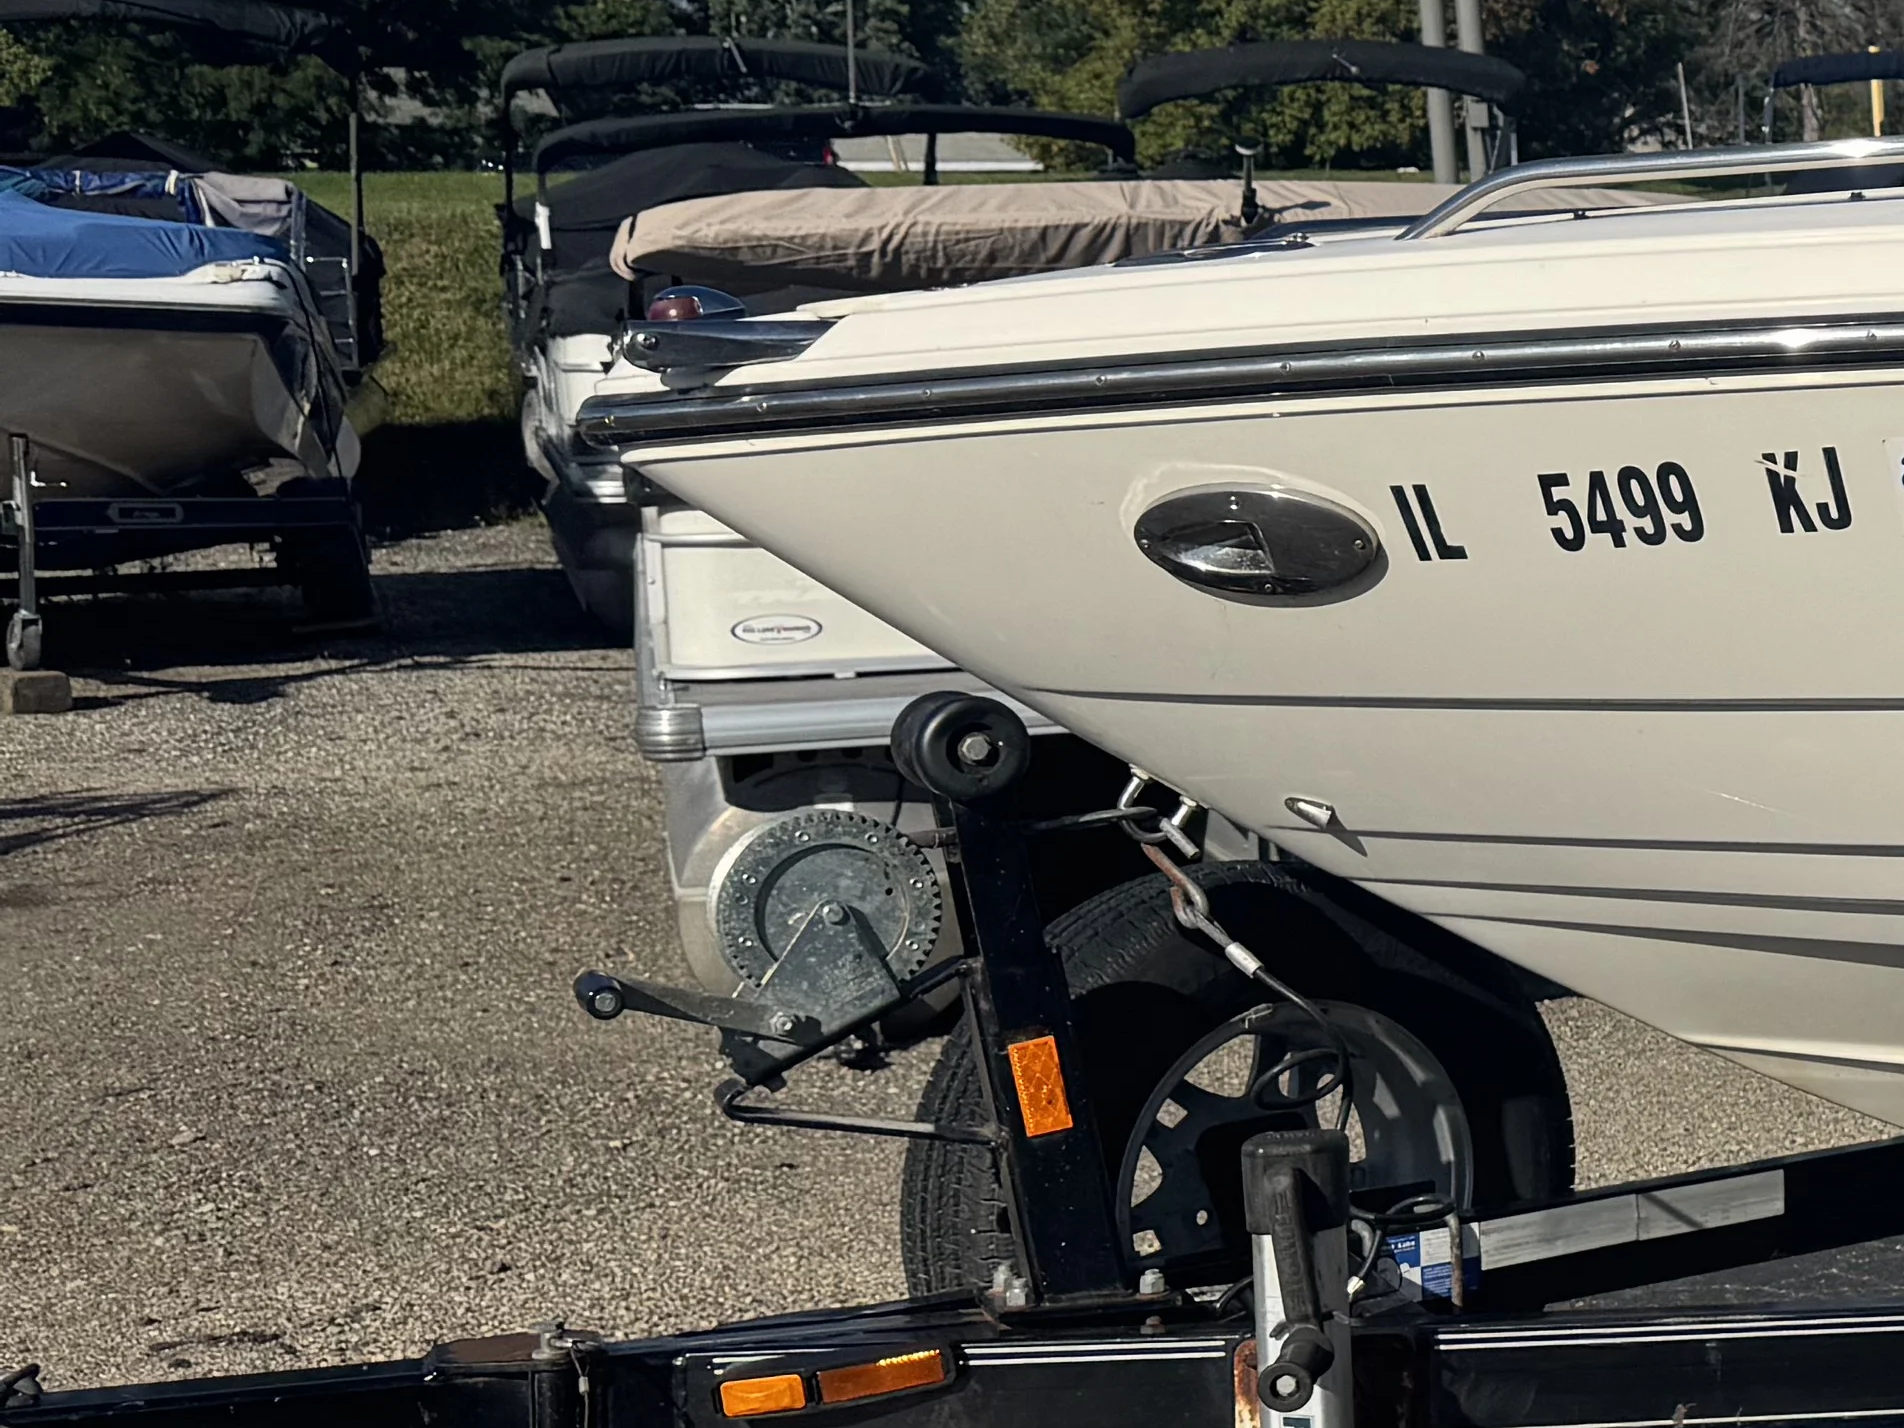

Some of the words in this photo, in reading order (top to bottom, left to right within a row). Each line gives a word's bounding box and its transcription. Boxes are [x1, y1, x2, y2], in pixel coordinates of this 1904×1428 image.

[1389, 484, 1468, 562] IL
[1537, 461, 1705, 552] 5499
[1760, 446, 1853, 534] KJ
